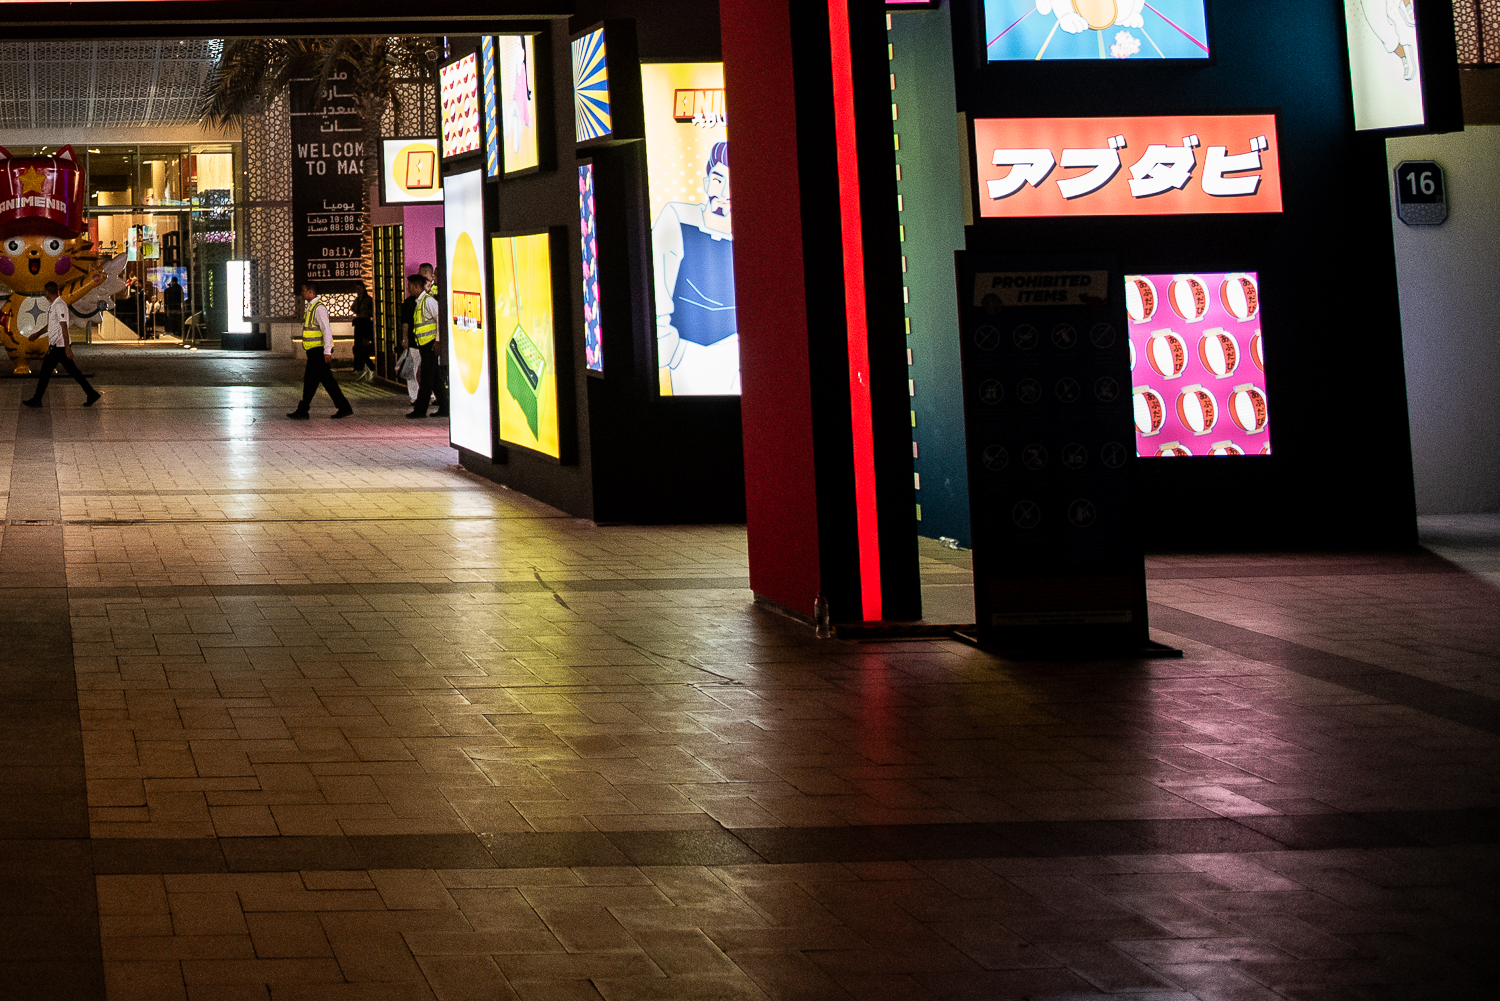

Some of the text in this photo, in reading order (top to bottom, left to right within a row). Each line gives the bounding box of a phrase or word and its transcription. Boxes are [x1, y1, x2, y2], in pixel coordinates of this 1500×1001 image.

[675, 90, 725, 117] ANI
[305, 160, 326, 176] TO
[986, 134, 1268, 199] アブダビ
[1406, 171, 1435, 195] 16
[0, 196, 67, 214] ANIMENIA
[322, 247, 354, 258] Daily
[307, 261, 361, 270] from 10:00
[307, 269, 331, 278] until
[991, 274, 1092, 289] PROHIBITED
[1017, 289, 1068, 303] ITEMS
